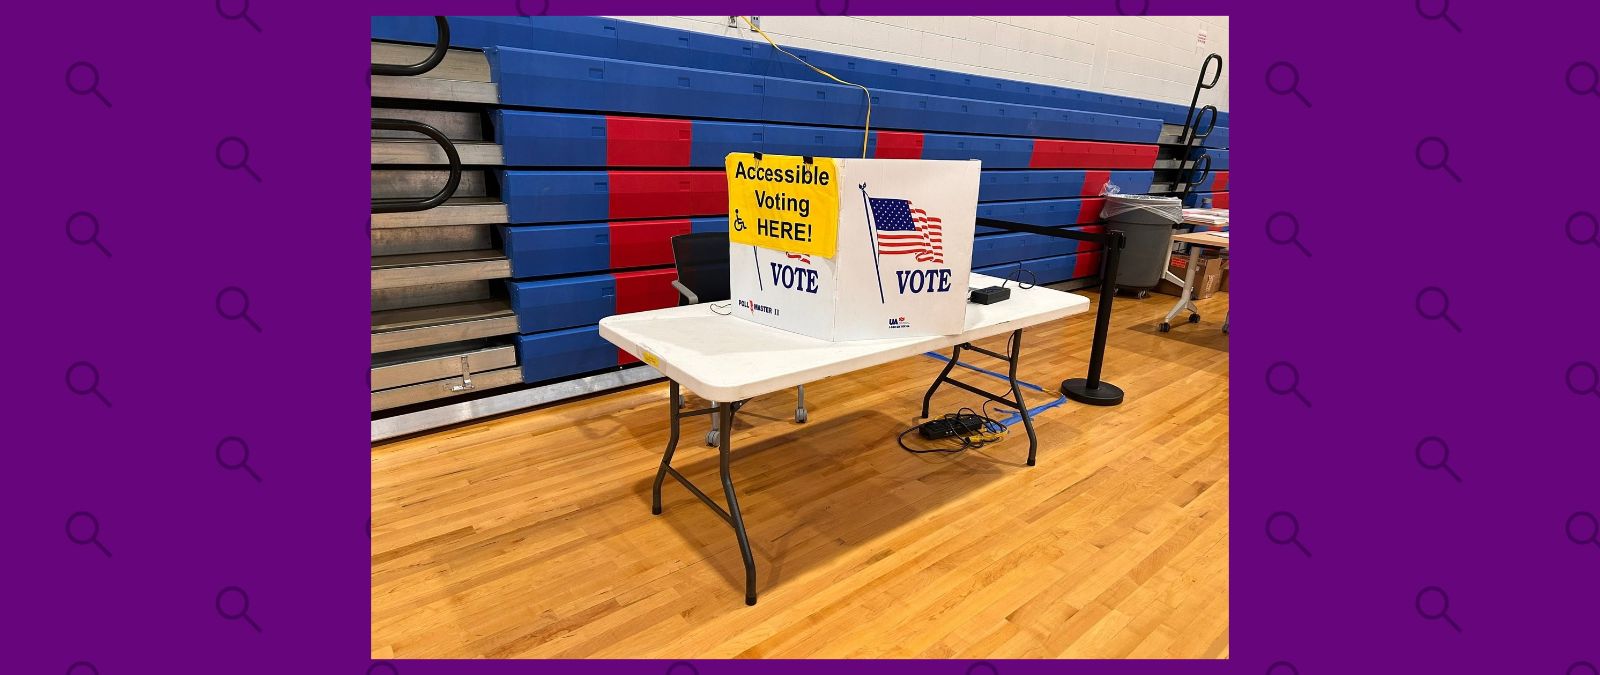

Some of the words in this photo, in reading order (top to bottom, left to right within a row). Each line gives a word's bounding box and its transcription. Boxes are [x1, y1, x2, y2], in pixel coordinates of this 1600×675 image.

[735, 161, 829, 186] Accessible
[755, 190, 810, 217] Voting
[757, 218, 812, 242] HERE!
[770, 262, 819, 294] VOTE
[896, 269, 952, 295] VOTE
[738, 299, 750, 308] POLL
[753, 303, 773, 314] MASTER
